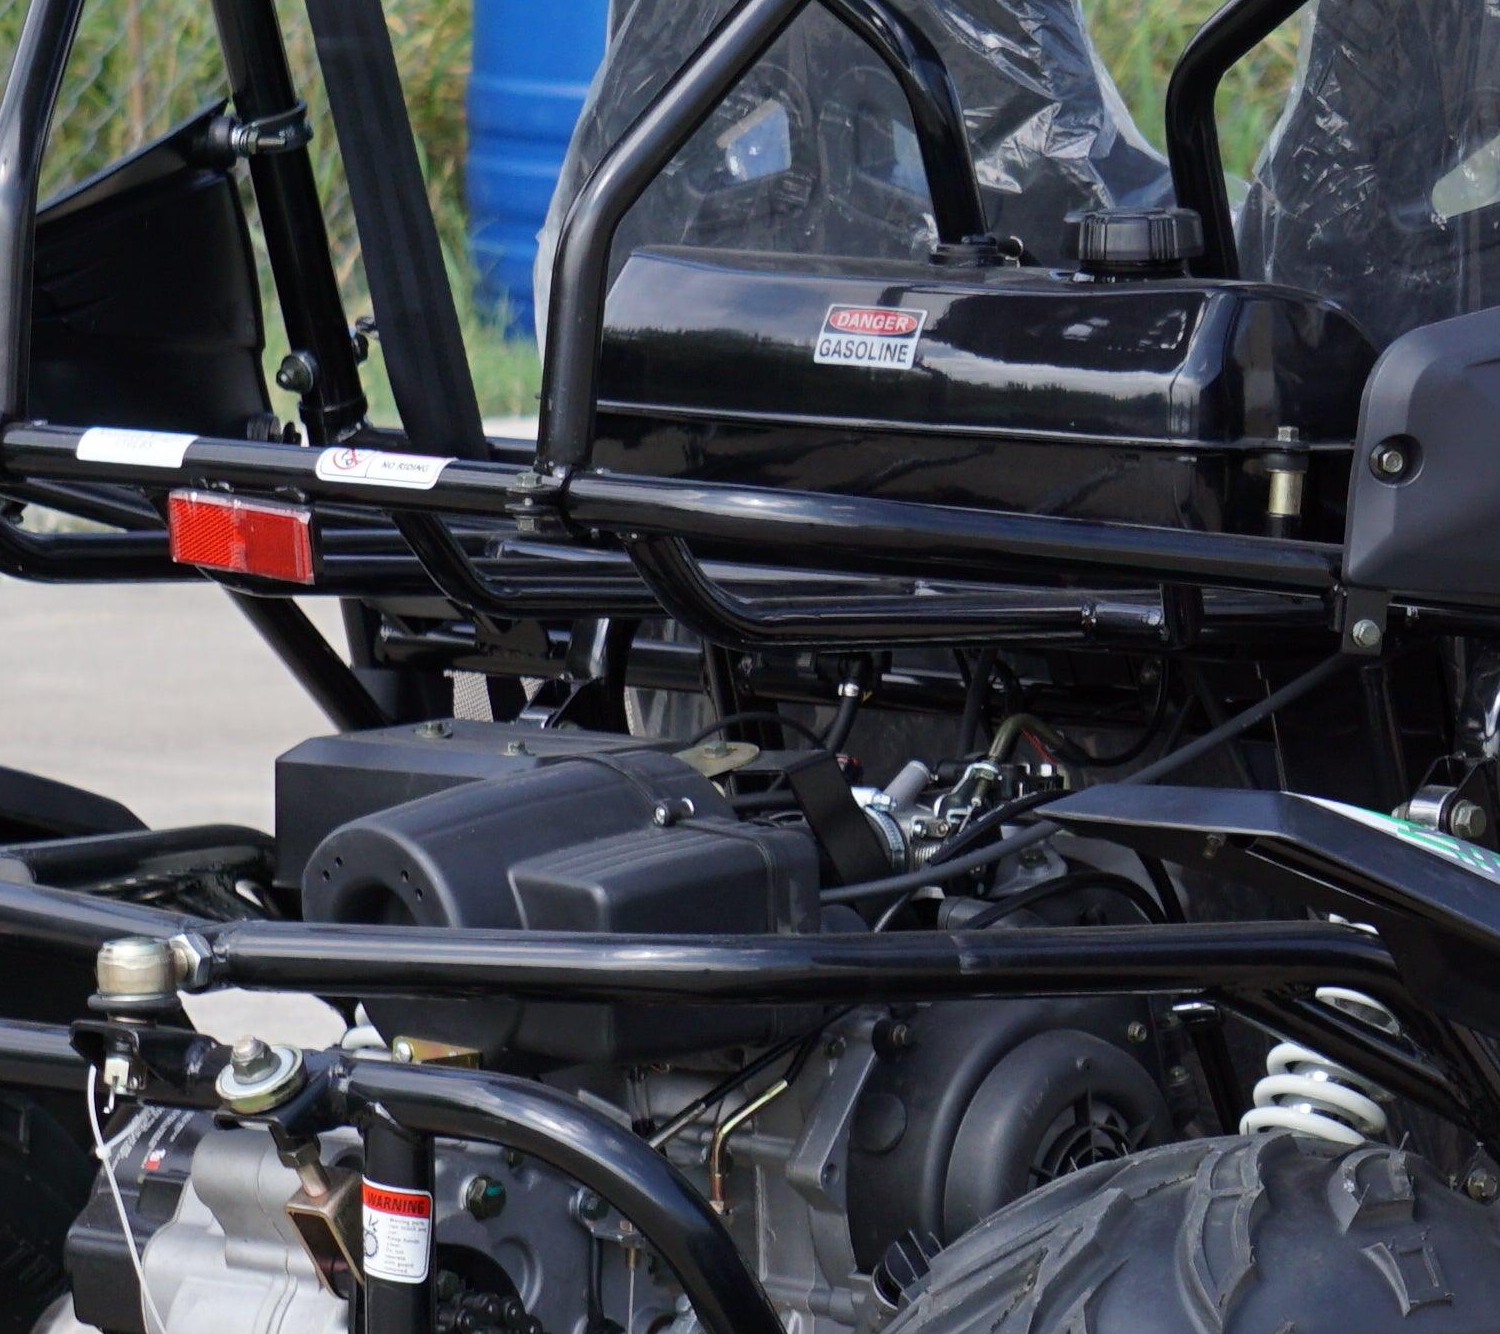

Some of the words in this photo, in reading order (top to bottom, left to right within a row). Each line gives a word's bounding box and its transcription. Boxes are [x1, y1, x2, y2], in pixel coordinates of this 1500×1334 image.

[836, 312, 910, 332] DANGER
[819, 338, 910, 364] GASOLINE
[367, 1192, 426, 1214] WARNING
